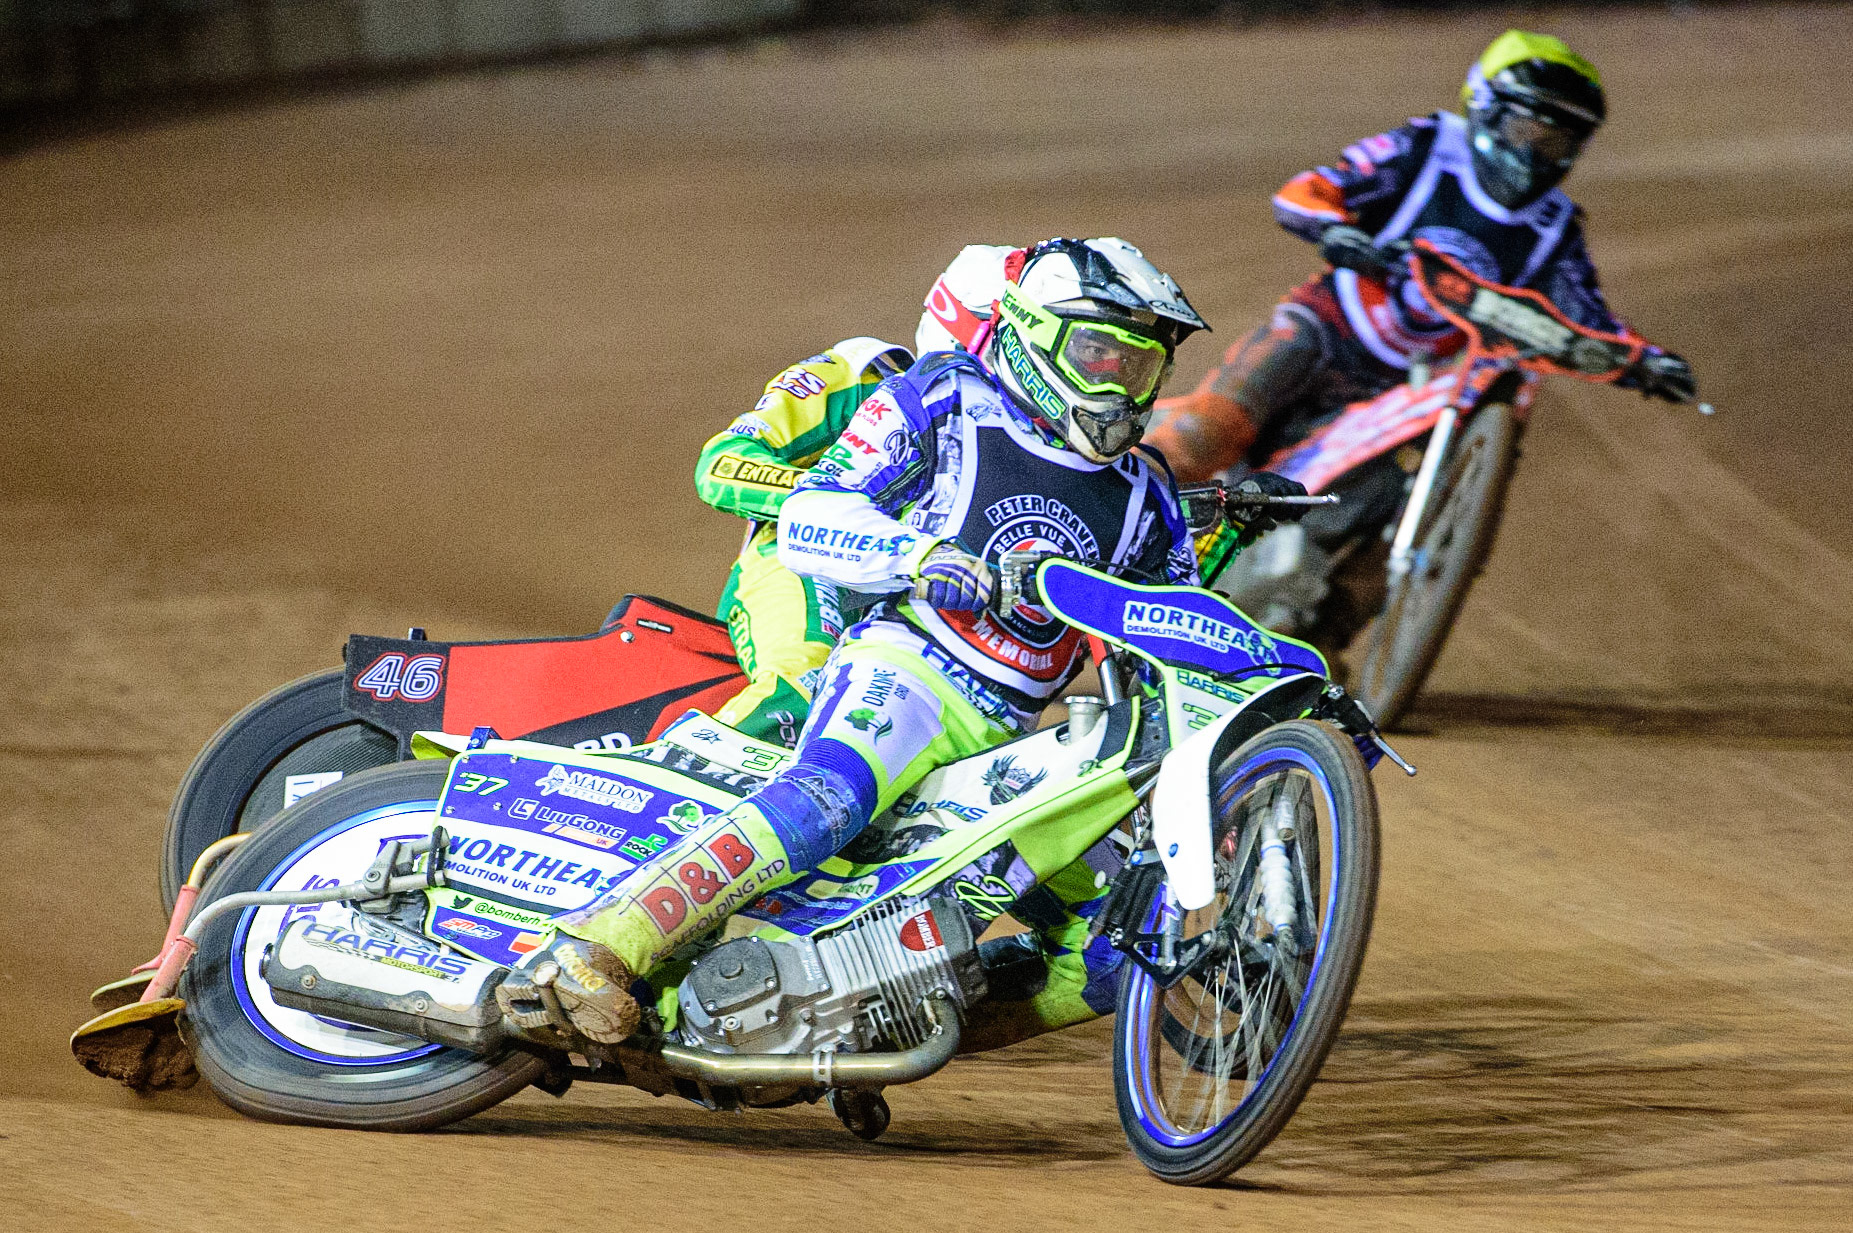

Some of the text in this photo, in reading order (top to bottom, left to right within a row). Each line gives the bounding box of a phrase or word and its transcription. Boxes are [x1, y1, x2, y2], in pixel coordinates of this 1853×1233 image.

[1003, 287, 1045, 330] ENNY
[1002, 325, 1067, 419] HARRIS
[984, 494, 1045, 526] PETER
[788, 543, 862, 563] DEMOLITION UK LTD
[993, 524, 1067, 555] BELLE VUE
[971, 619, 1055, 671] MEMORIAL
[1127, 624, 1227, 652] DEMOLITION UK LTD
[355, 653, 444, 701] 46
[1177, 670, 1246, 704] HARRIS
[563, 786, 640, 812] METALS LTD
[571, 773, 650, 803] MALDON
[448, 835, 630, 894] NORTHEAS
[624, 841, 653, 856] ROCK
[443, 859, 557, 897] MOLITION UK LTD
[642, 834, 754, 934] D&B
[757, 859, 785, 884] LTD
[474, 902, 541, 926] @bomberh
[302, 923, 473, 975] HARRIS
[381, 957, 443, 979] MOTORSPORT
